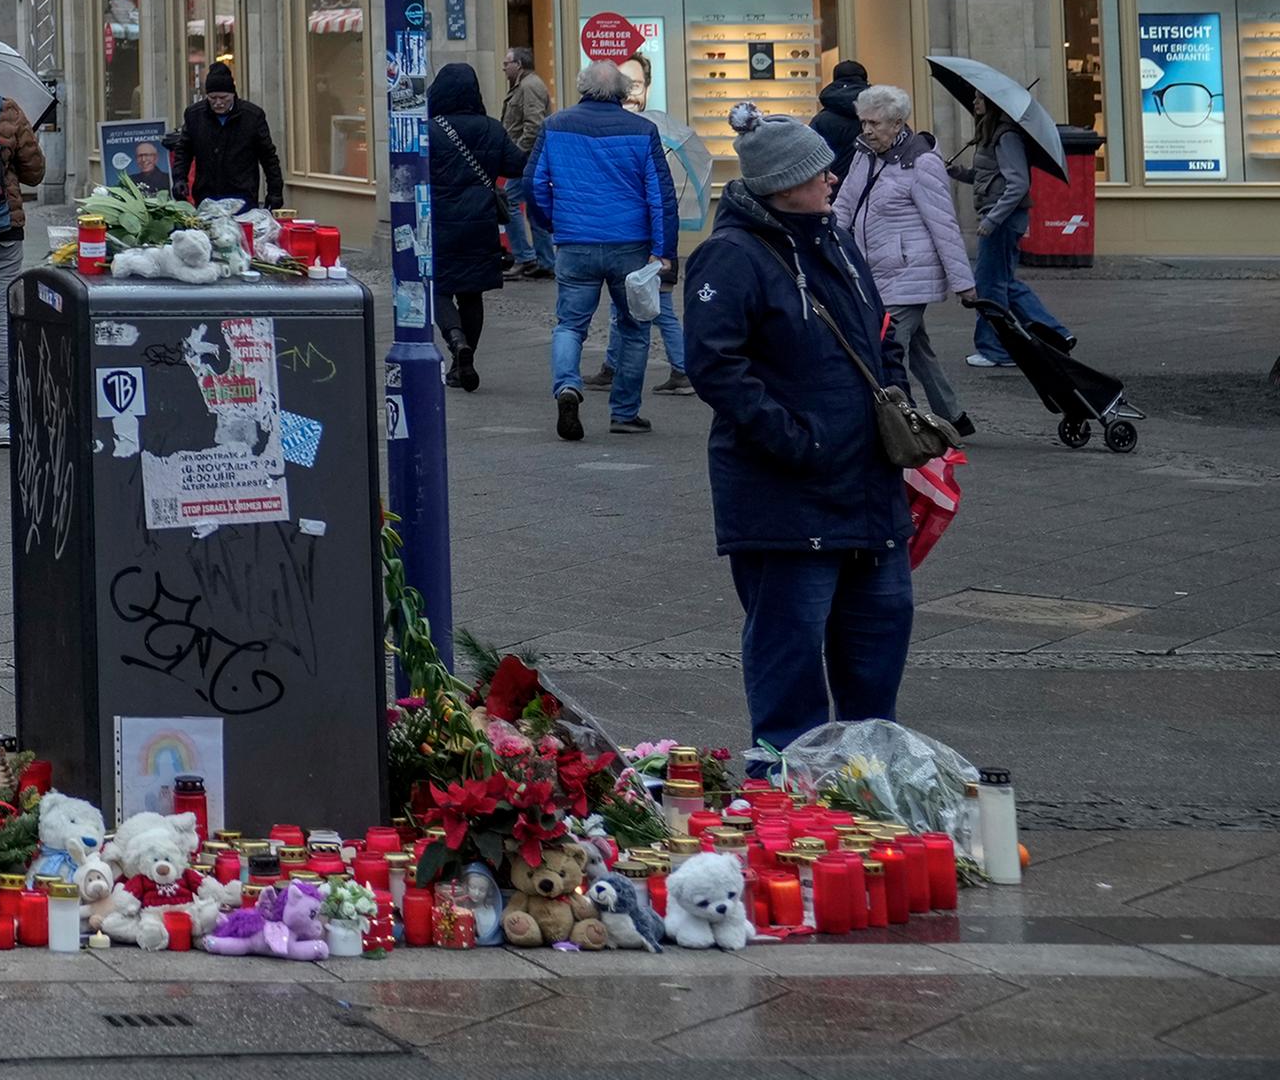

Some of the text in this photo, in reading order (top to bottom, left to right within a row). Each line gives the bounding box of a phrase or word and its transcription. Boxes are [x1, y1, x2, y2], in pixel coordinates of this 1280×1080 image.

[586, 30, 615, 38] GLÄSER
[1140, 25, 1212, 40] LEITSICHT
[1153, 44, 1214, 53] MIT ERFOLGS-
[1166, 53, 1211, 62] GARANTIE
[1189, 160, 1215, 170] KIND
